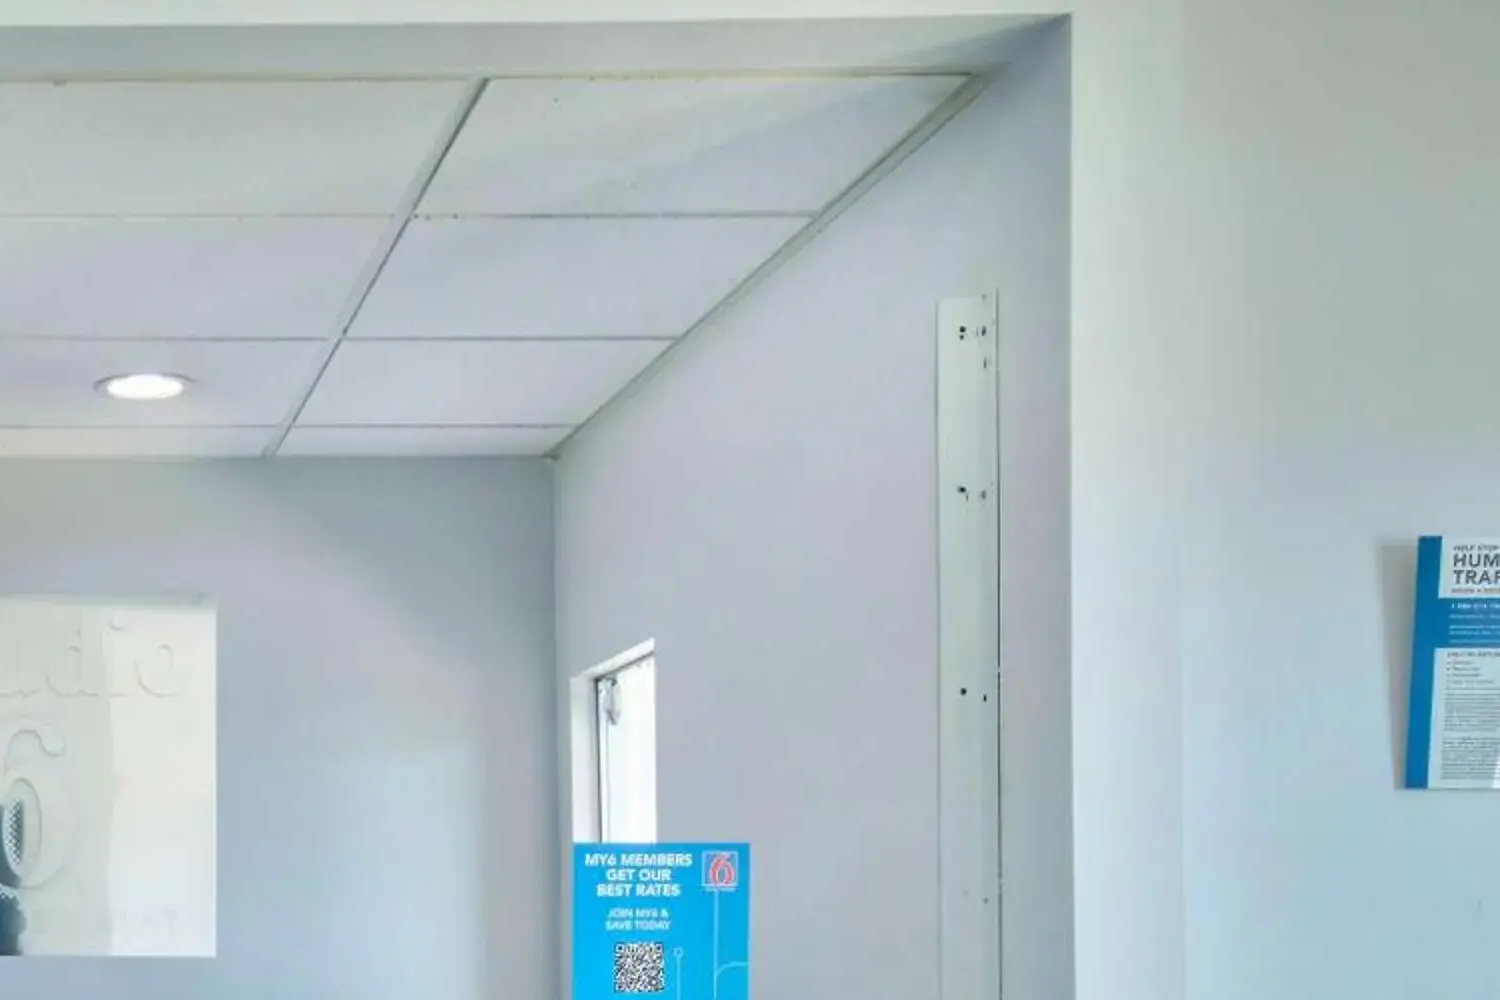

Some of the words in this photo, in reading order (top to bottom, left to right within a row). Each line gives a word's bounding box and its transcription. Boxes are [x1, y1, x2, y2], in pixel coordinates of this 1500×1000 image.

[585, 853, 616, 866] MY6
[621, 853, 693, 867] MEMBERS
[606, 868, 635, 881] GET
[638, 868, 672, 881] OUR
[597, 883, 633, 897] BEST
[636, 883, 681, 897] RATES
[608, 907, 633, 918] JOIN
[606, 920, 633, 931] SAVE
[635, 920, 671, 931] TODAY
